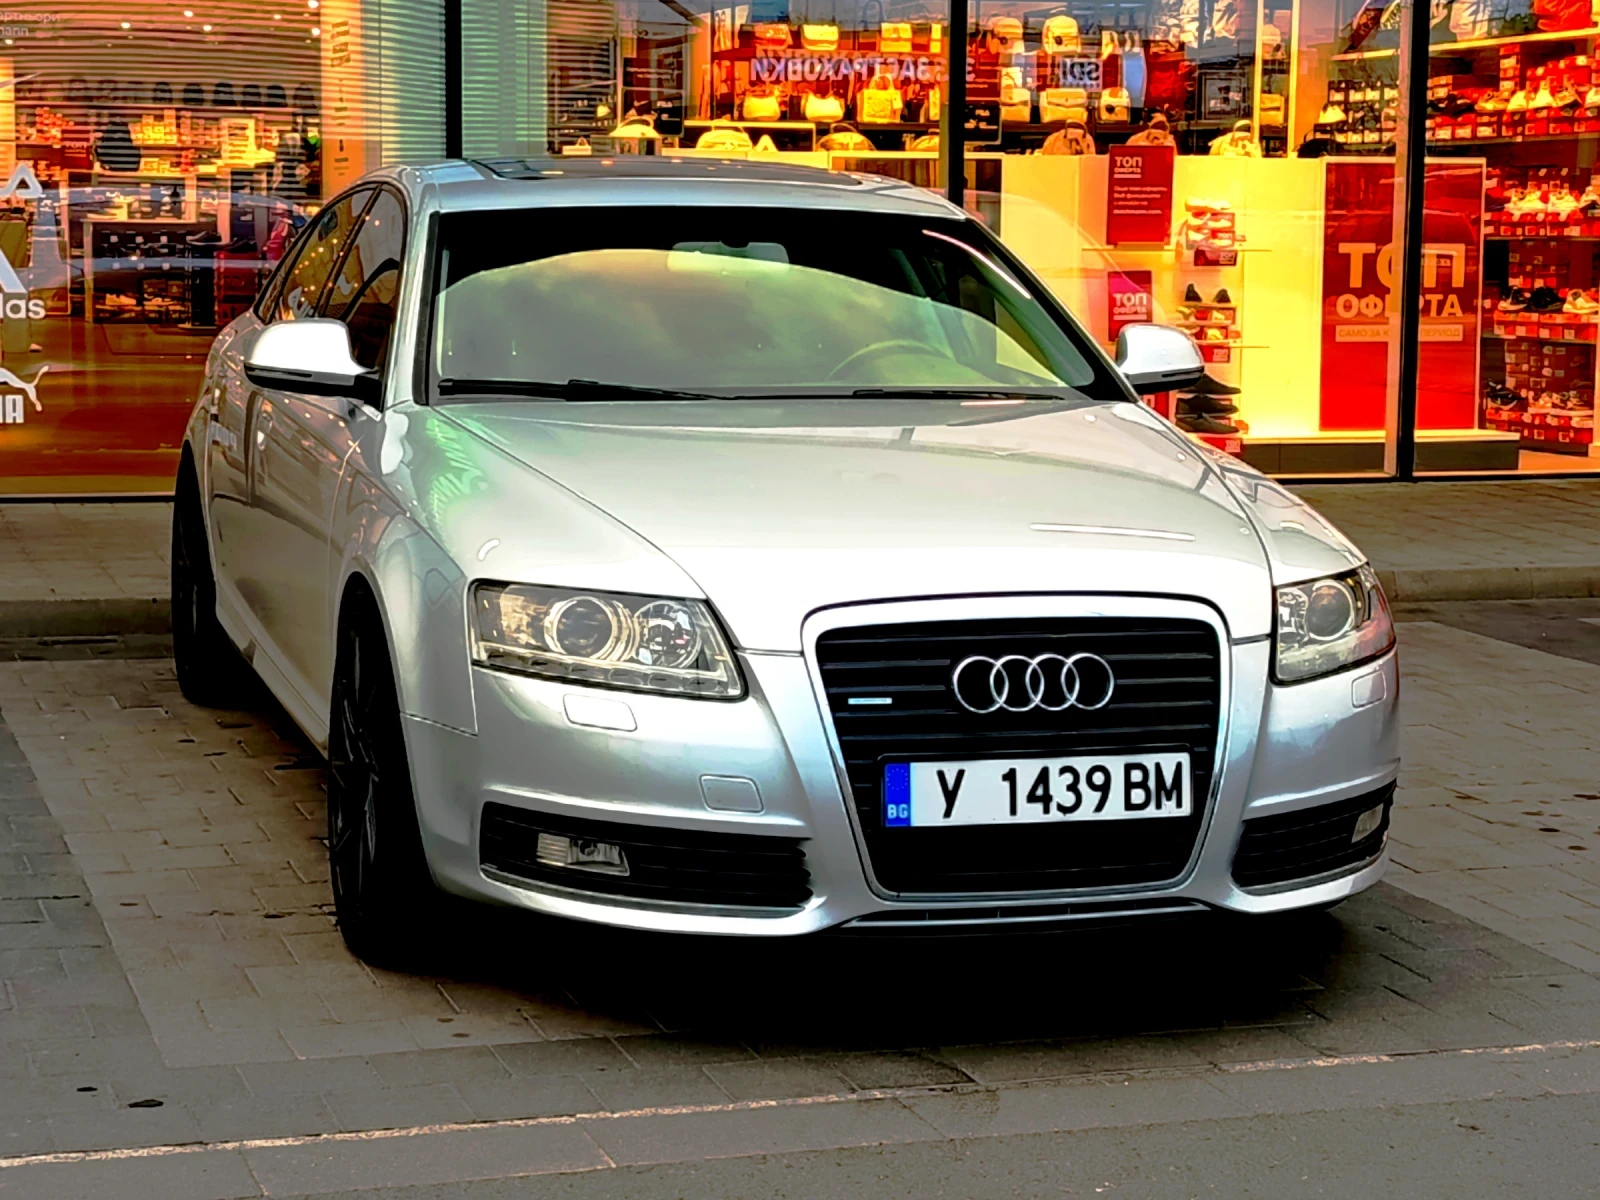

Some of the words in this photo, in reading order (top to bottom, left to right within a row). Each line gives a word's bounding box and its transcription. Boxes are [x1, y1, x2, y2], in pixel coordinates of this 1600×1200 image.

[1114, 156, 1143, 168] ТОП
[1112, 292, 1147, 307] ТОП
[1001, 765, 1113, 817] 1439
[1123, 761, 1183, 812] BM
[887, 804, 908, 818] BG
